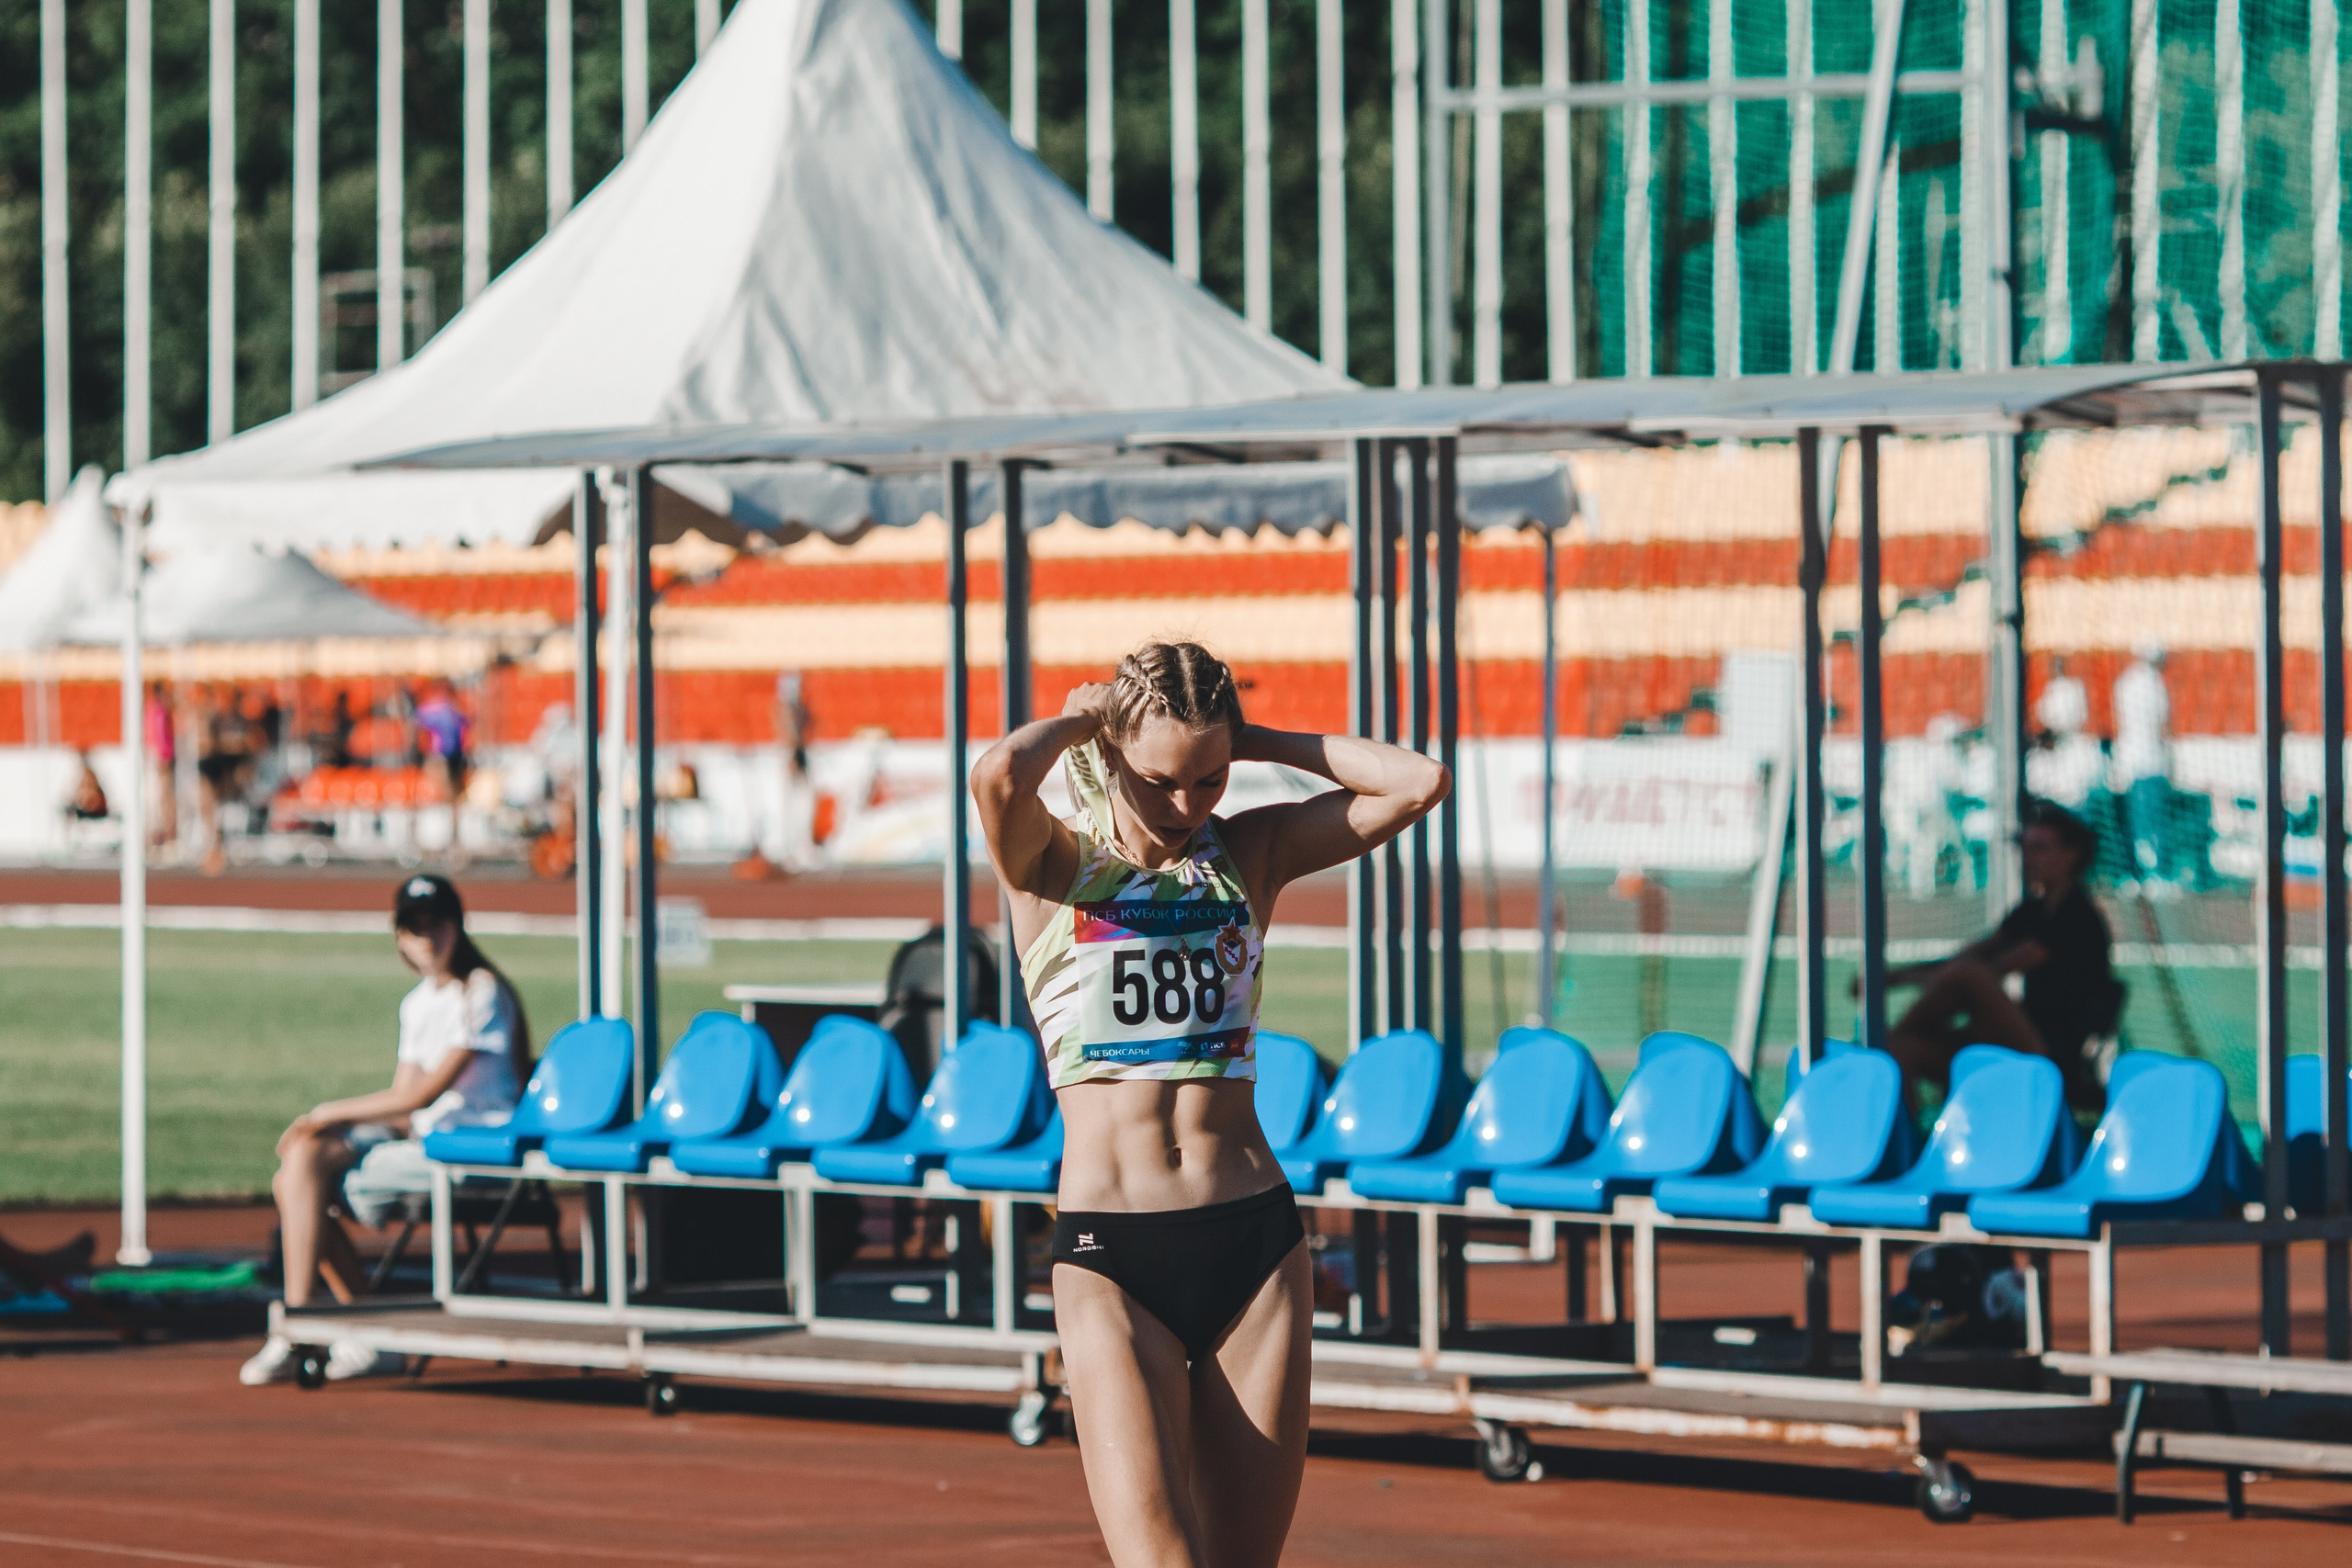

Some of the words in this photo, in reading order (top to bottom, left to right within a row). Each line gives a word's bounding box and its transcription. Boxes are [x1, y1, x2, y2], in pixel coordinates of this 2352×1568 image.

[1083, 909, 1116, 921] ПСБ
[1121, 908, 1170, 919] КУБОК
[1175, 908, 1237, 919] РОССИИ
[1113, 950, 1225, 1025] 588
[1090, 1048, 1150, 1057] ЧЕБОКСАРЫ
